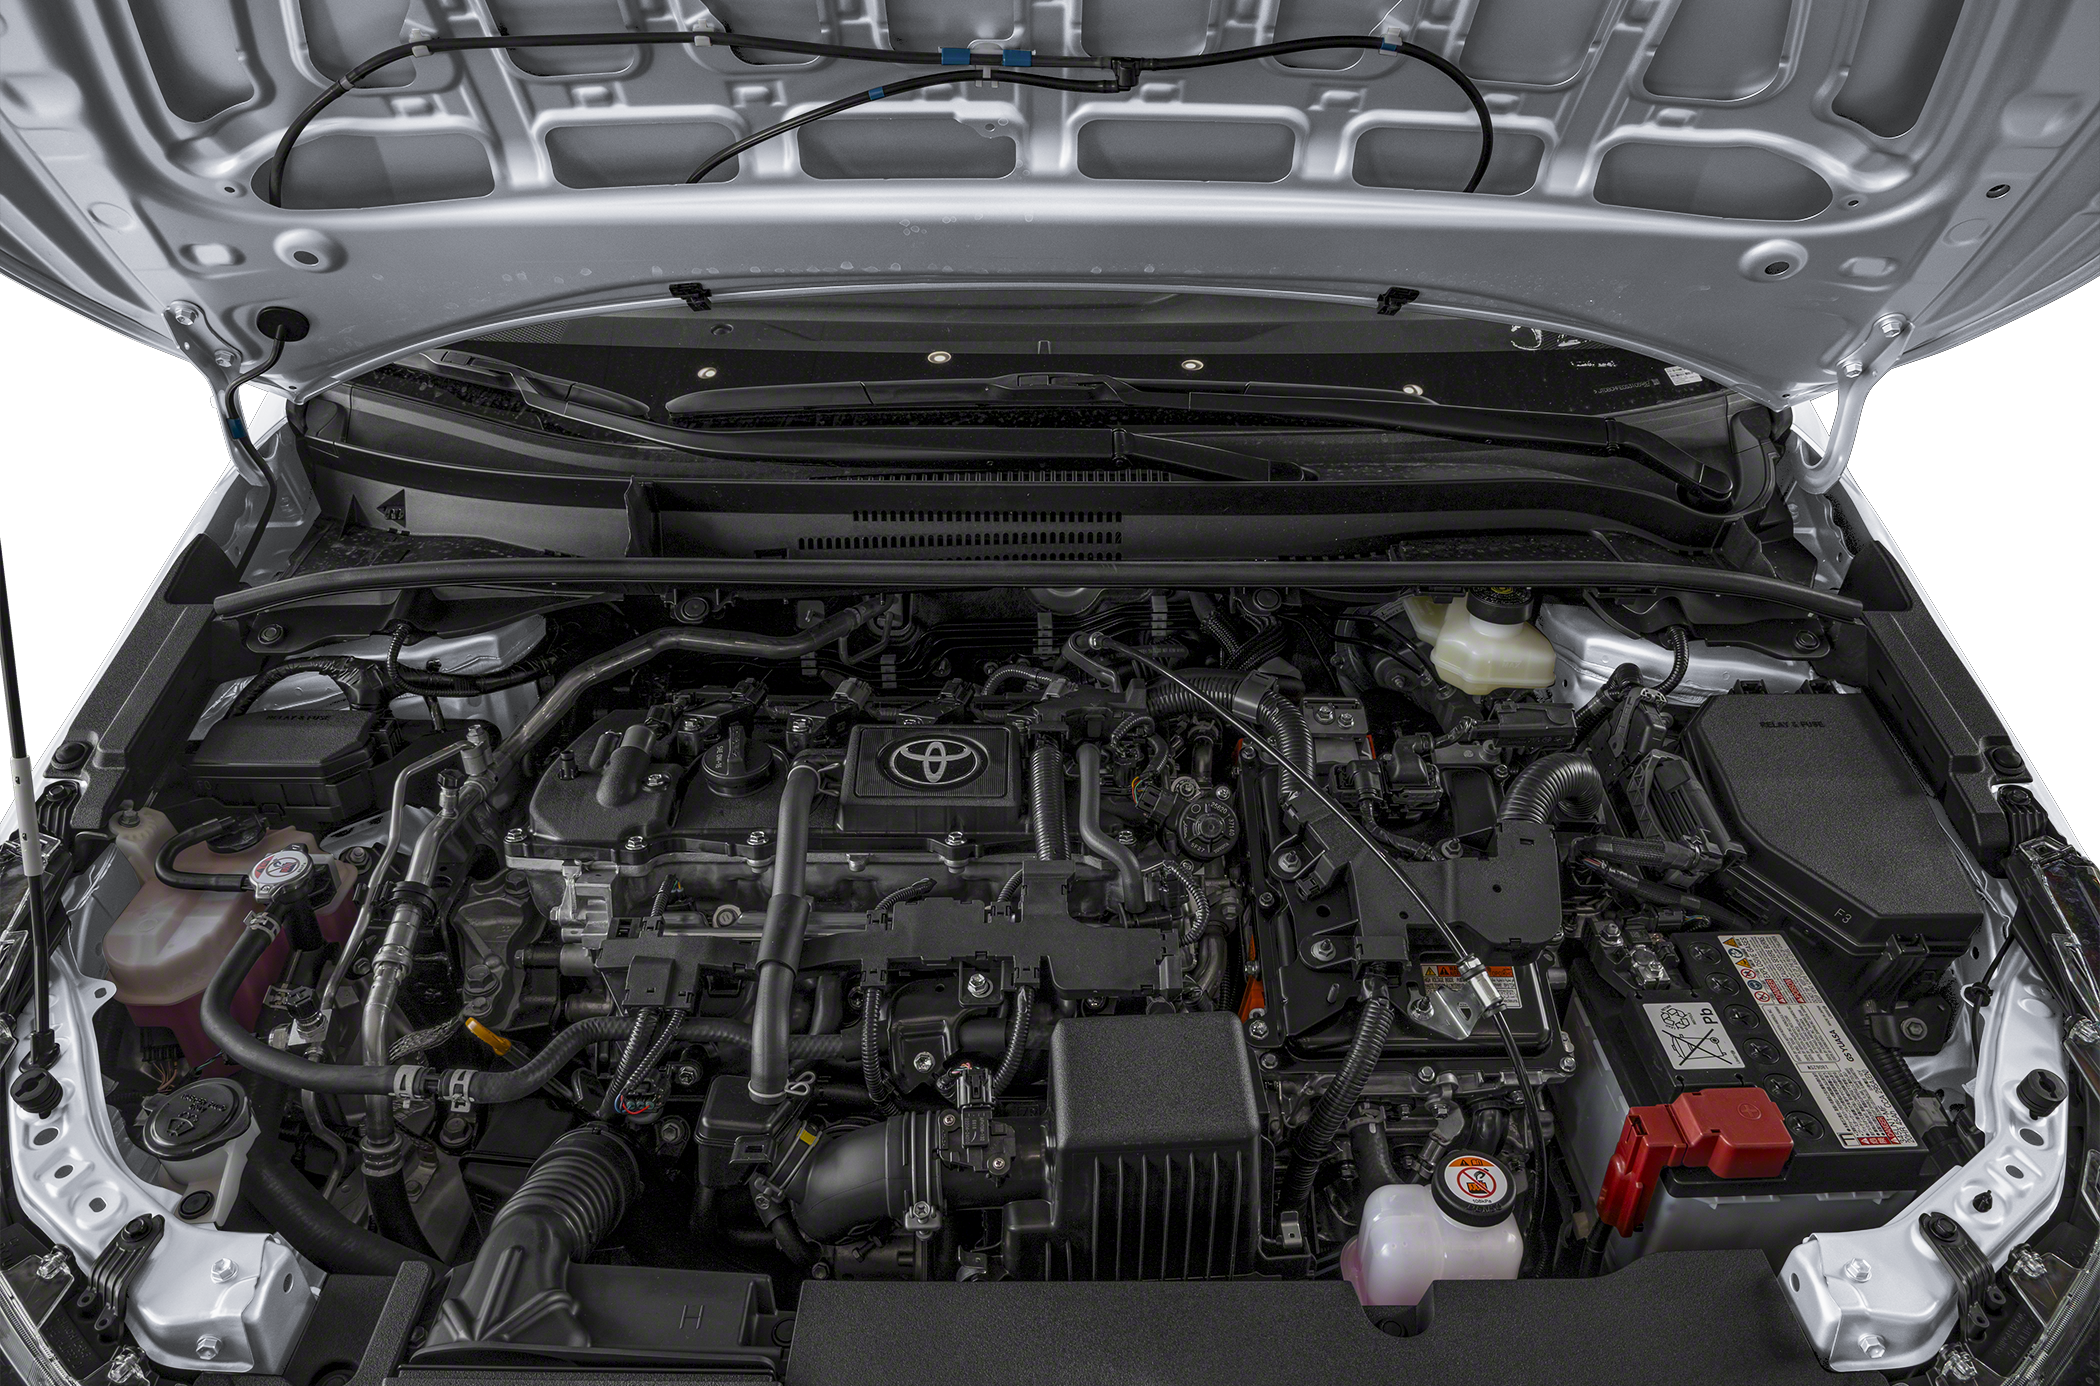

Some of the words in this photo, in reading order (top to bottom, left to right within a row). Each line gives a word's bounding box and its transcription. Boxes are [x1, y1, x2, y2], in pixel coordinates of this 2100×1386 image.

[1760, 721, 1789, 729] RELAY
[1800, 721, 1826, 729] FUSE
[1210, 801, 1228, 814] 25620
[1833, 907, 1853, 924] F3
[1766, 979, 1784, 999] DANGER
[1784, 978, 1803, 998] POISON
[1699, 1007, 1718, 1025] Pb
[1827, 1029, 1850, 1052] YUASA
[1876, 1116, 1895, 1137] DANGER
[679, 1304, 705, 1330] H
